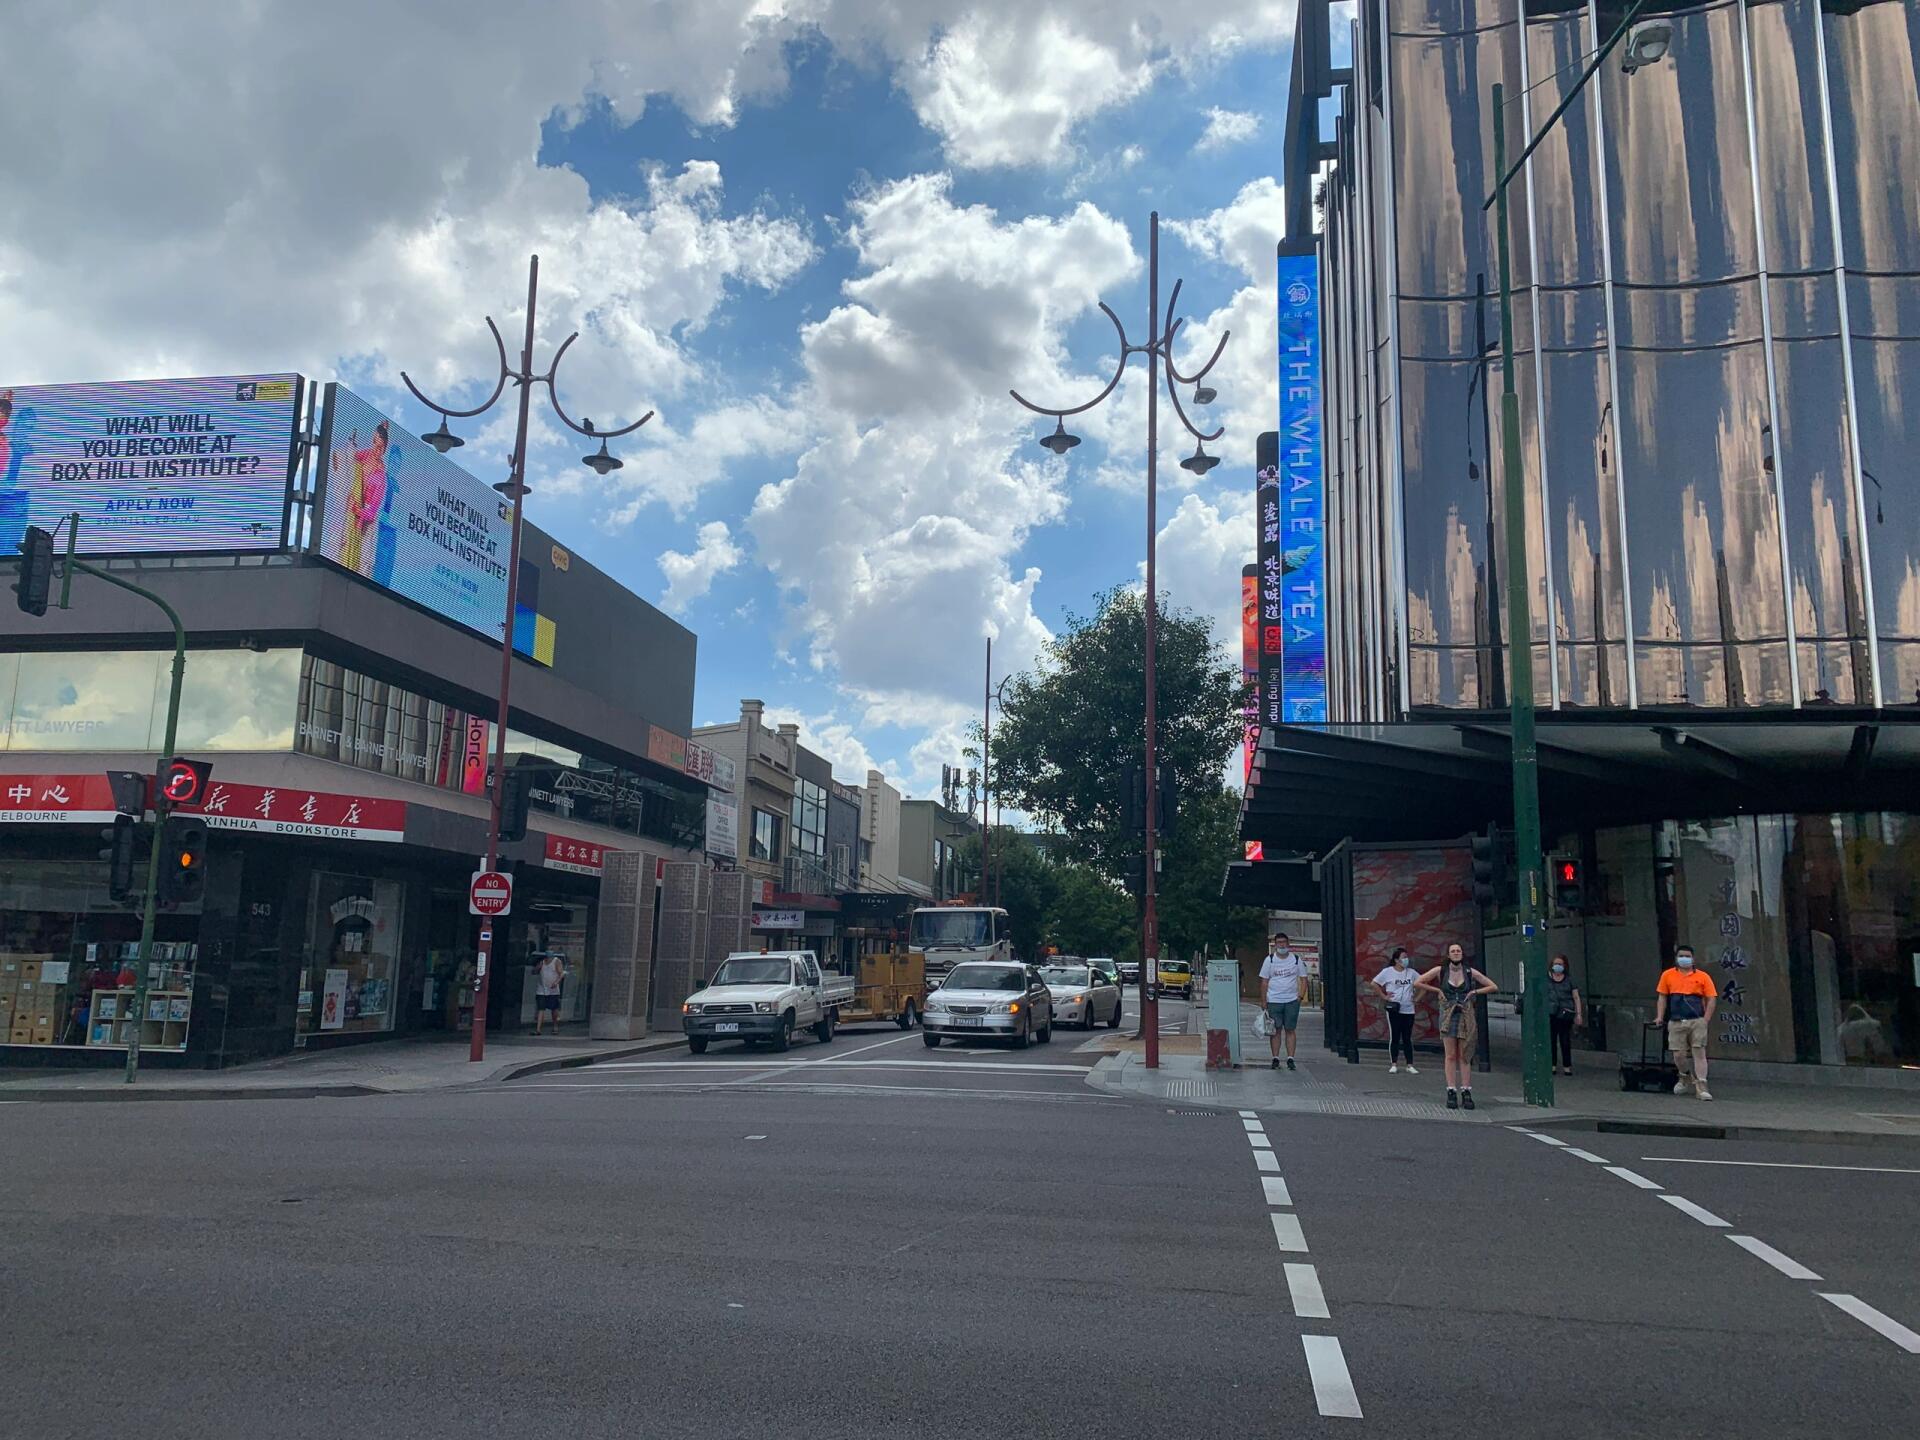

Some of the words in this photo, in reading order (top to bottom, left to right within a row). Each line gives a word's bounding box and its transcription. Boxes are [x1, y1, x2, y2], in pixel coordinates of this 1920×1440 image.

[1289, 338, 1312, 402] THE
[105, 415, 164, 436] WHAT
[168, 413, 216, 433] WILL
[82, 439, 121, 459] YOU
[125, 435, 208, 457] BECOME
[210, 434, 237, 453] AT
[51, 462, 93, 482] BOX
[97, 460, 139, 480] HILL
[144, 456, 261, 479] INSTITUTE?
[1289, 416, 1314, 534] WHALE
[104, 498, 153, 512] APPLY
[158, 497, 196, 510] NOW
[438, 486, 467, 518] WHAT
[467, 506, 489, 534] WILL
[425, 500, 445, 526] YOU
[447, 514, 485, 549] BECOME
[486, 538, 498, 557] AT
[408, 512, 430, 540] BOX
[432, 526, 454, 552] HILL
[455, 540, 507, 582] INSTITUTE?
[1263, 555, 1281, 620] 北京味道
[1291, 579, 1316, 643] TEA
[8, 783, 70, 804] 中心
[1, 812, 67, 821] ELBOURNE
[204, 816, 258, 829] XINHUA
[276, 823, 358, 838] BOOKSTORE
[570, 864, 579, 872] AND
[485, 879, 499, 889] NO
[251, 903, 271, 916] 543
[476, 898, 505, 908] ENTRY
[1719, 1013, 1754, 1024] BANK
[1729, 1024, 1745, 1034] OF
[1718, 1033, 1759, 1045] CHINA
